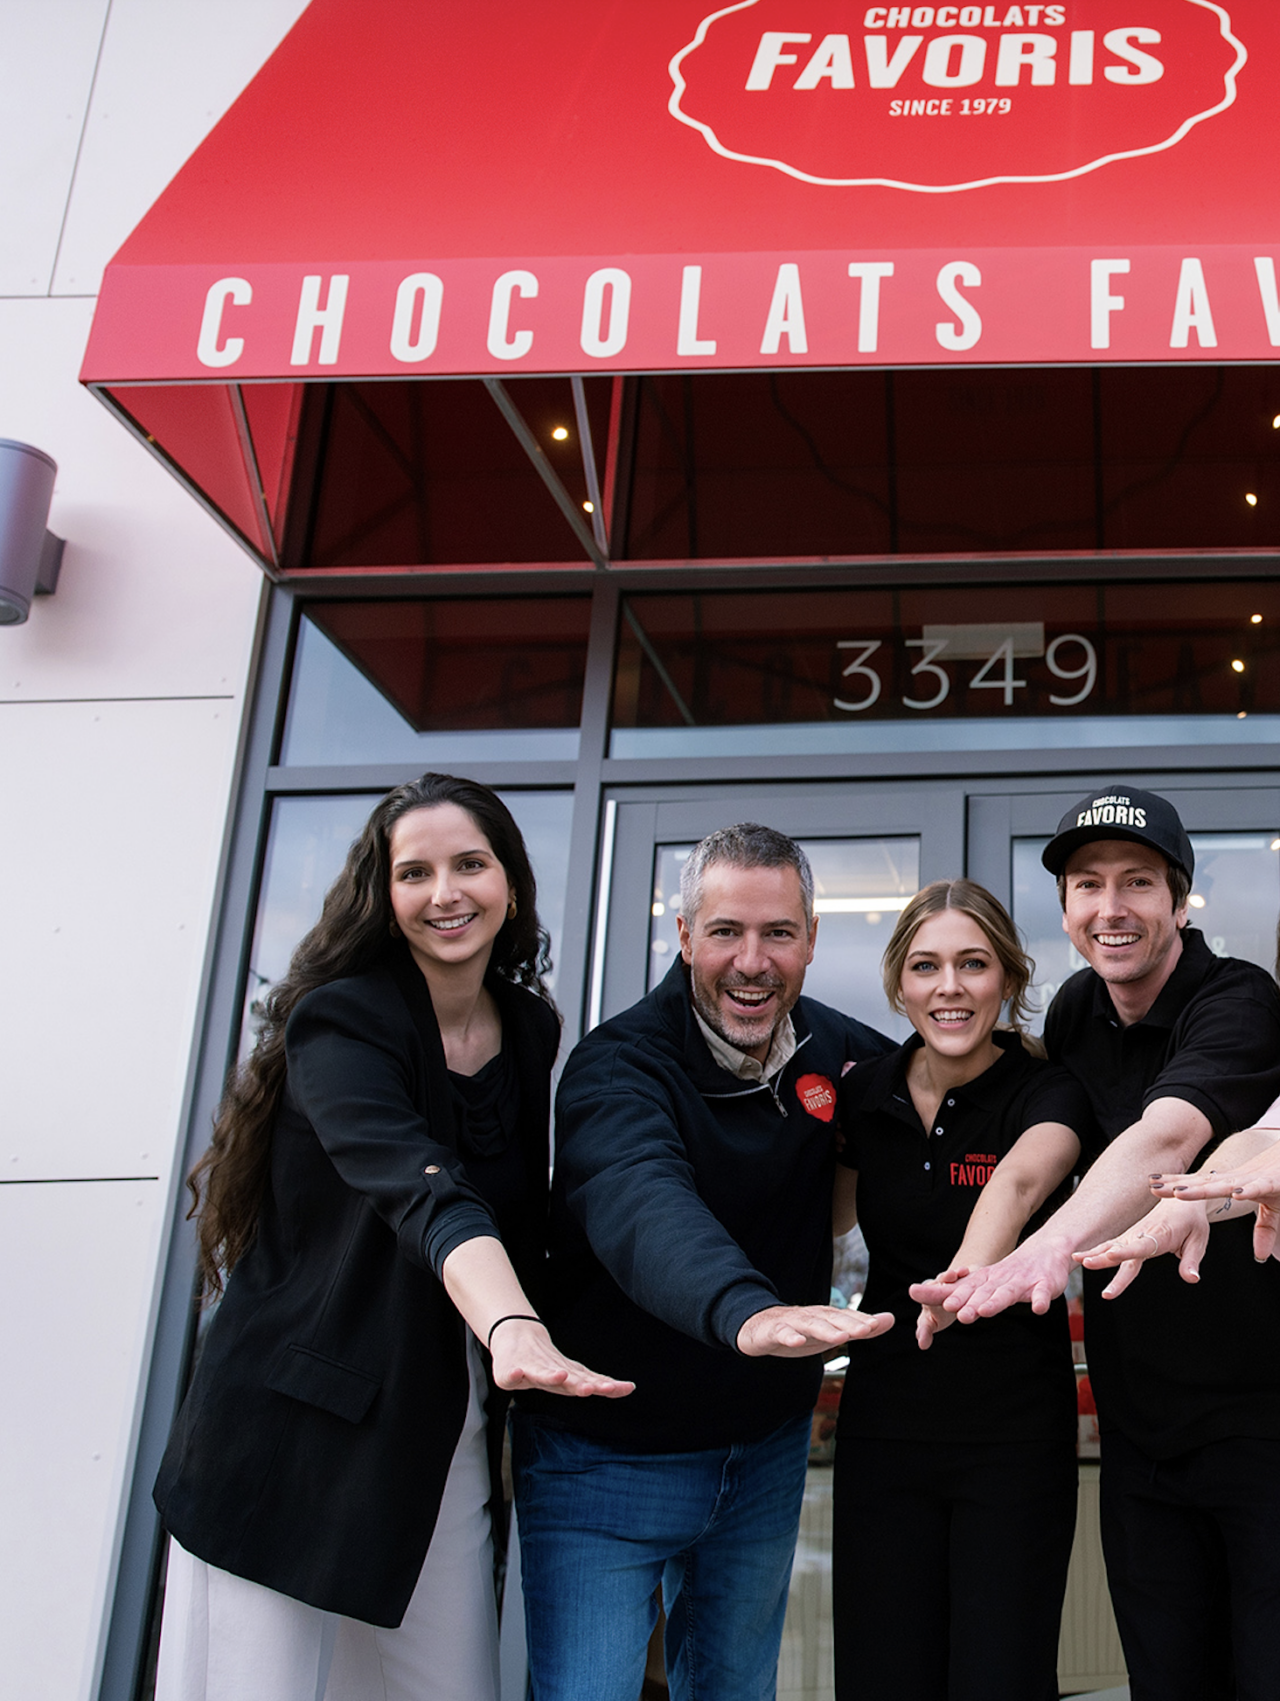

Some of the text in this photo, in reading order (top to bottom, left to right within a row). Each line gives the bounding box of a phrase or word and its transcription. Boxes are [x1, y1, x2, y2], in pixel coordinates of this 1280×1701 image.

[863, 5, 1066, 28] CHOCOLATS
[744, 27, 1165, 91] FAVORIS
[888, 98, 1012, 116] SINCE 1979
[196, 261, 983, 368] CHOCOLATS
[833, 633, 1098, 711] 3349
[1076, 805, 1147, 829] FAVORIS
[950, 1162, 996, 1187] FAVOR
